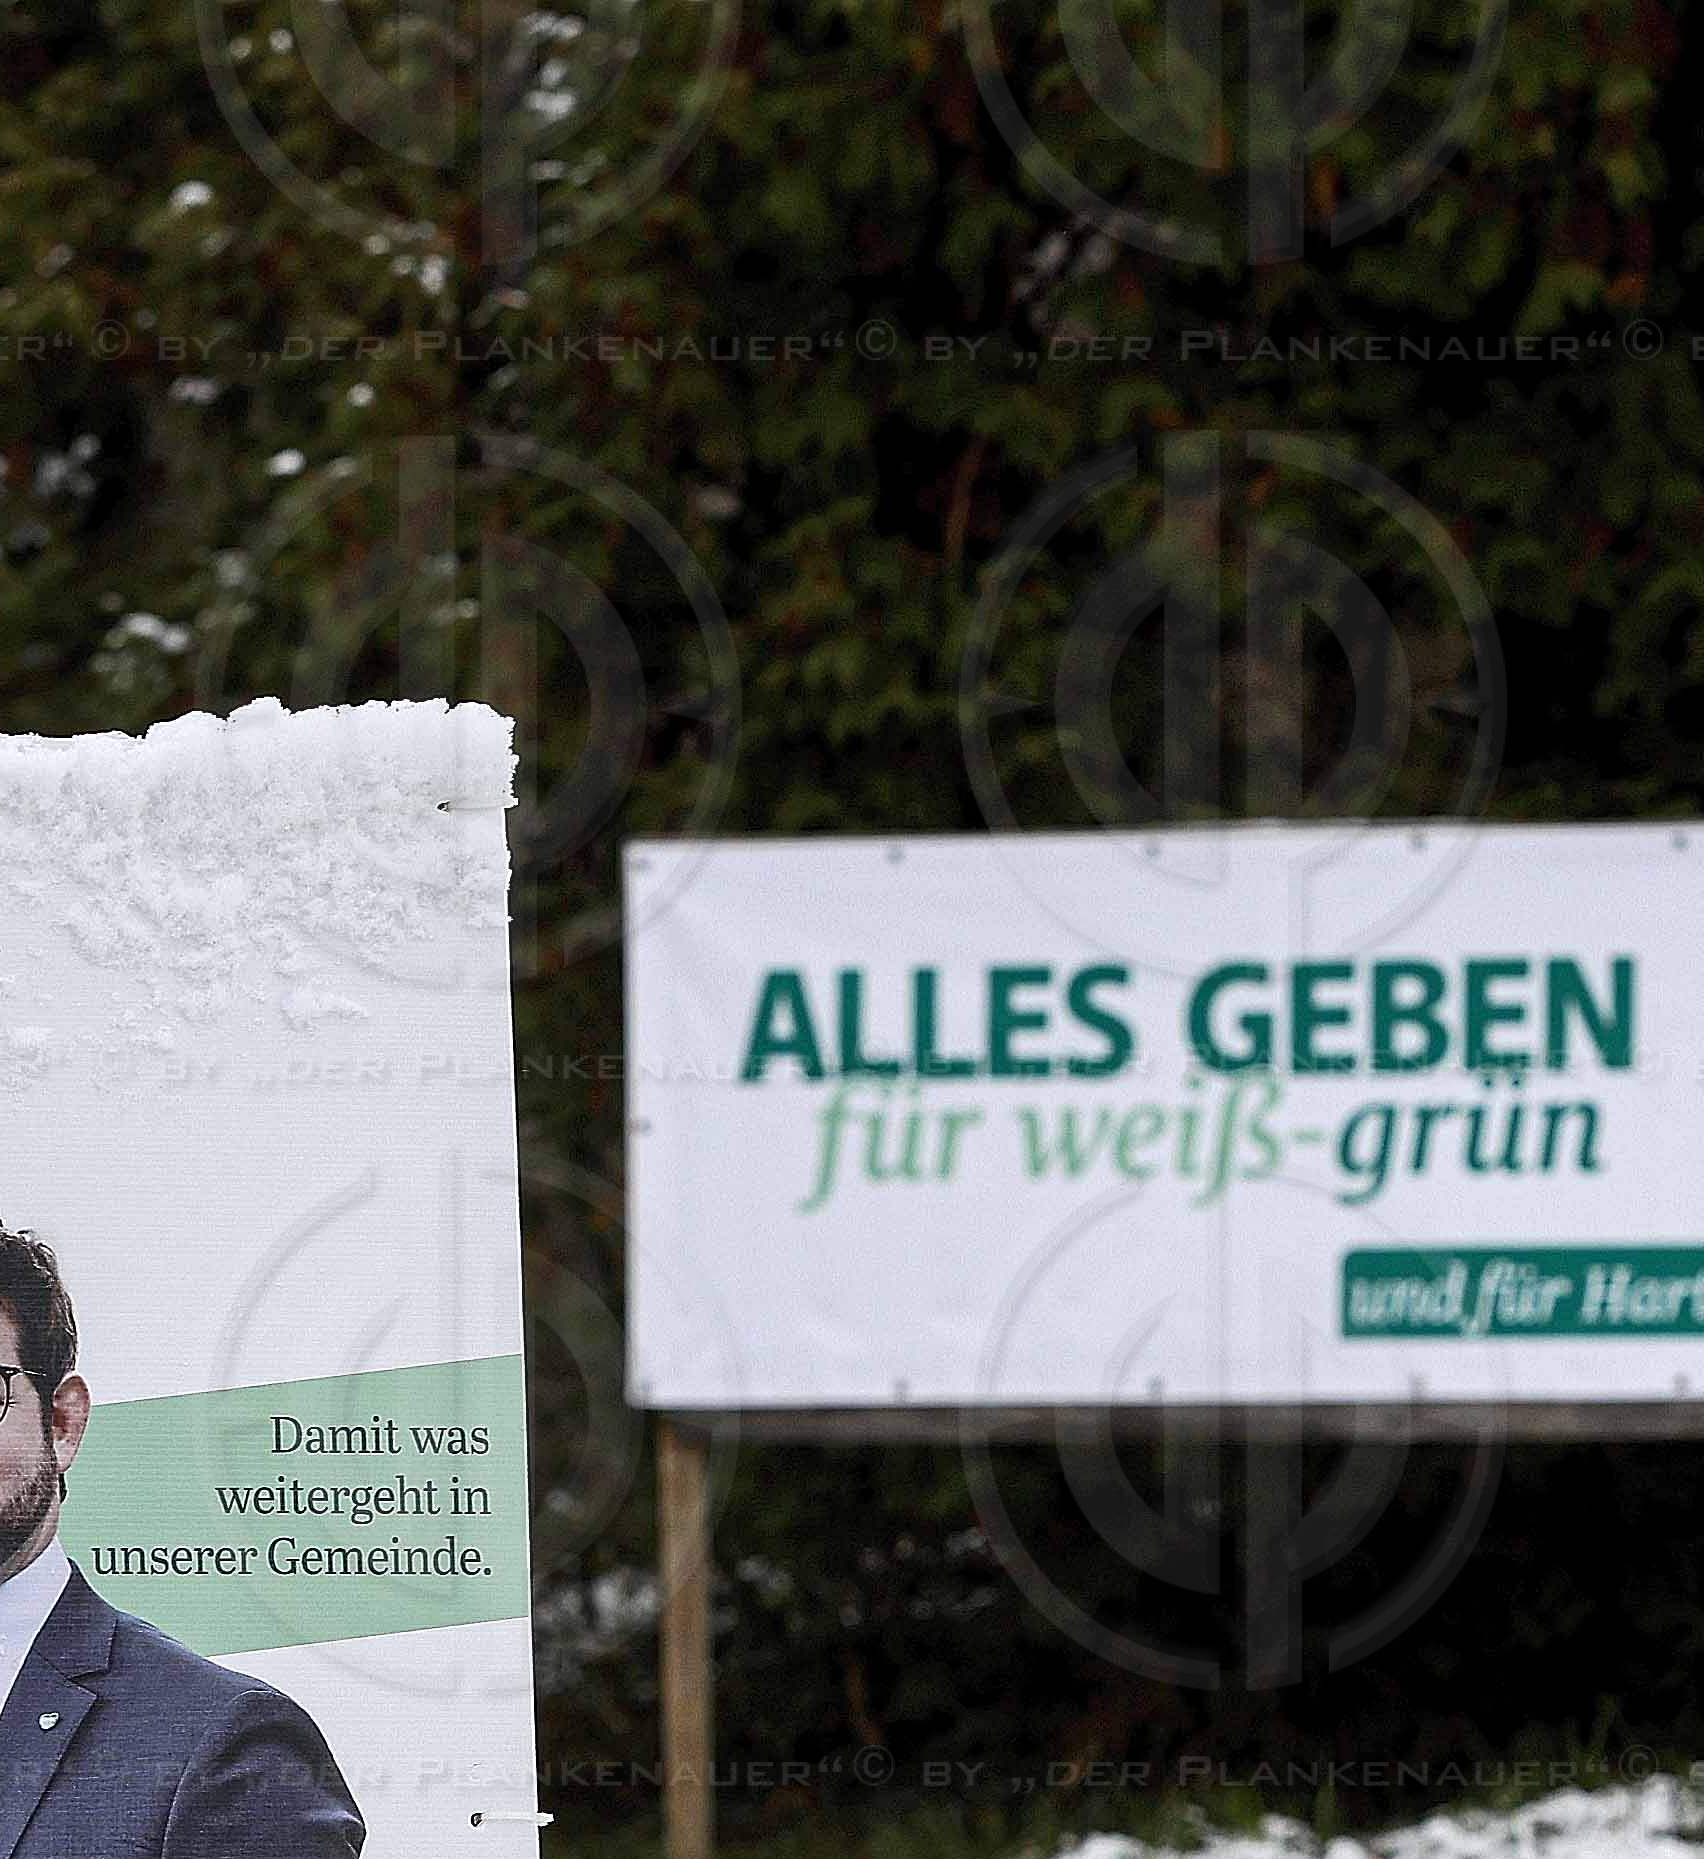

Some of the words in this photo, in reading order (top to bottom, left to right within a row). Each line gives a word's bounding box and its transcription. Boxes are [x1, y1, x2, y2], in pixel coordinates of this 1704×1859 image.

[739, 966, 1136, 1083] ALLES
[1186, 956, 1634, 1076] GEBEN
[798, 1074, 982, 1213] für
[1020, 1070, 1606, 1206] weiß-grün
[1350, 1260, 1466, 1325] und
[1460, 1258, 1572, 1337] für
[270, 1416, 402, 1455] Damit
[410, 1425, 490, 1455] was
[215, 1475, 442, 1525] weitergeht
[449, 1476, 493, 1515] in
[92, 1545, 258, 1576] unserer
[267, 1536, 493, 1576] Gemeinde.
